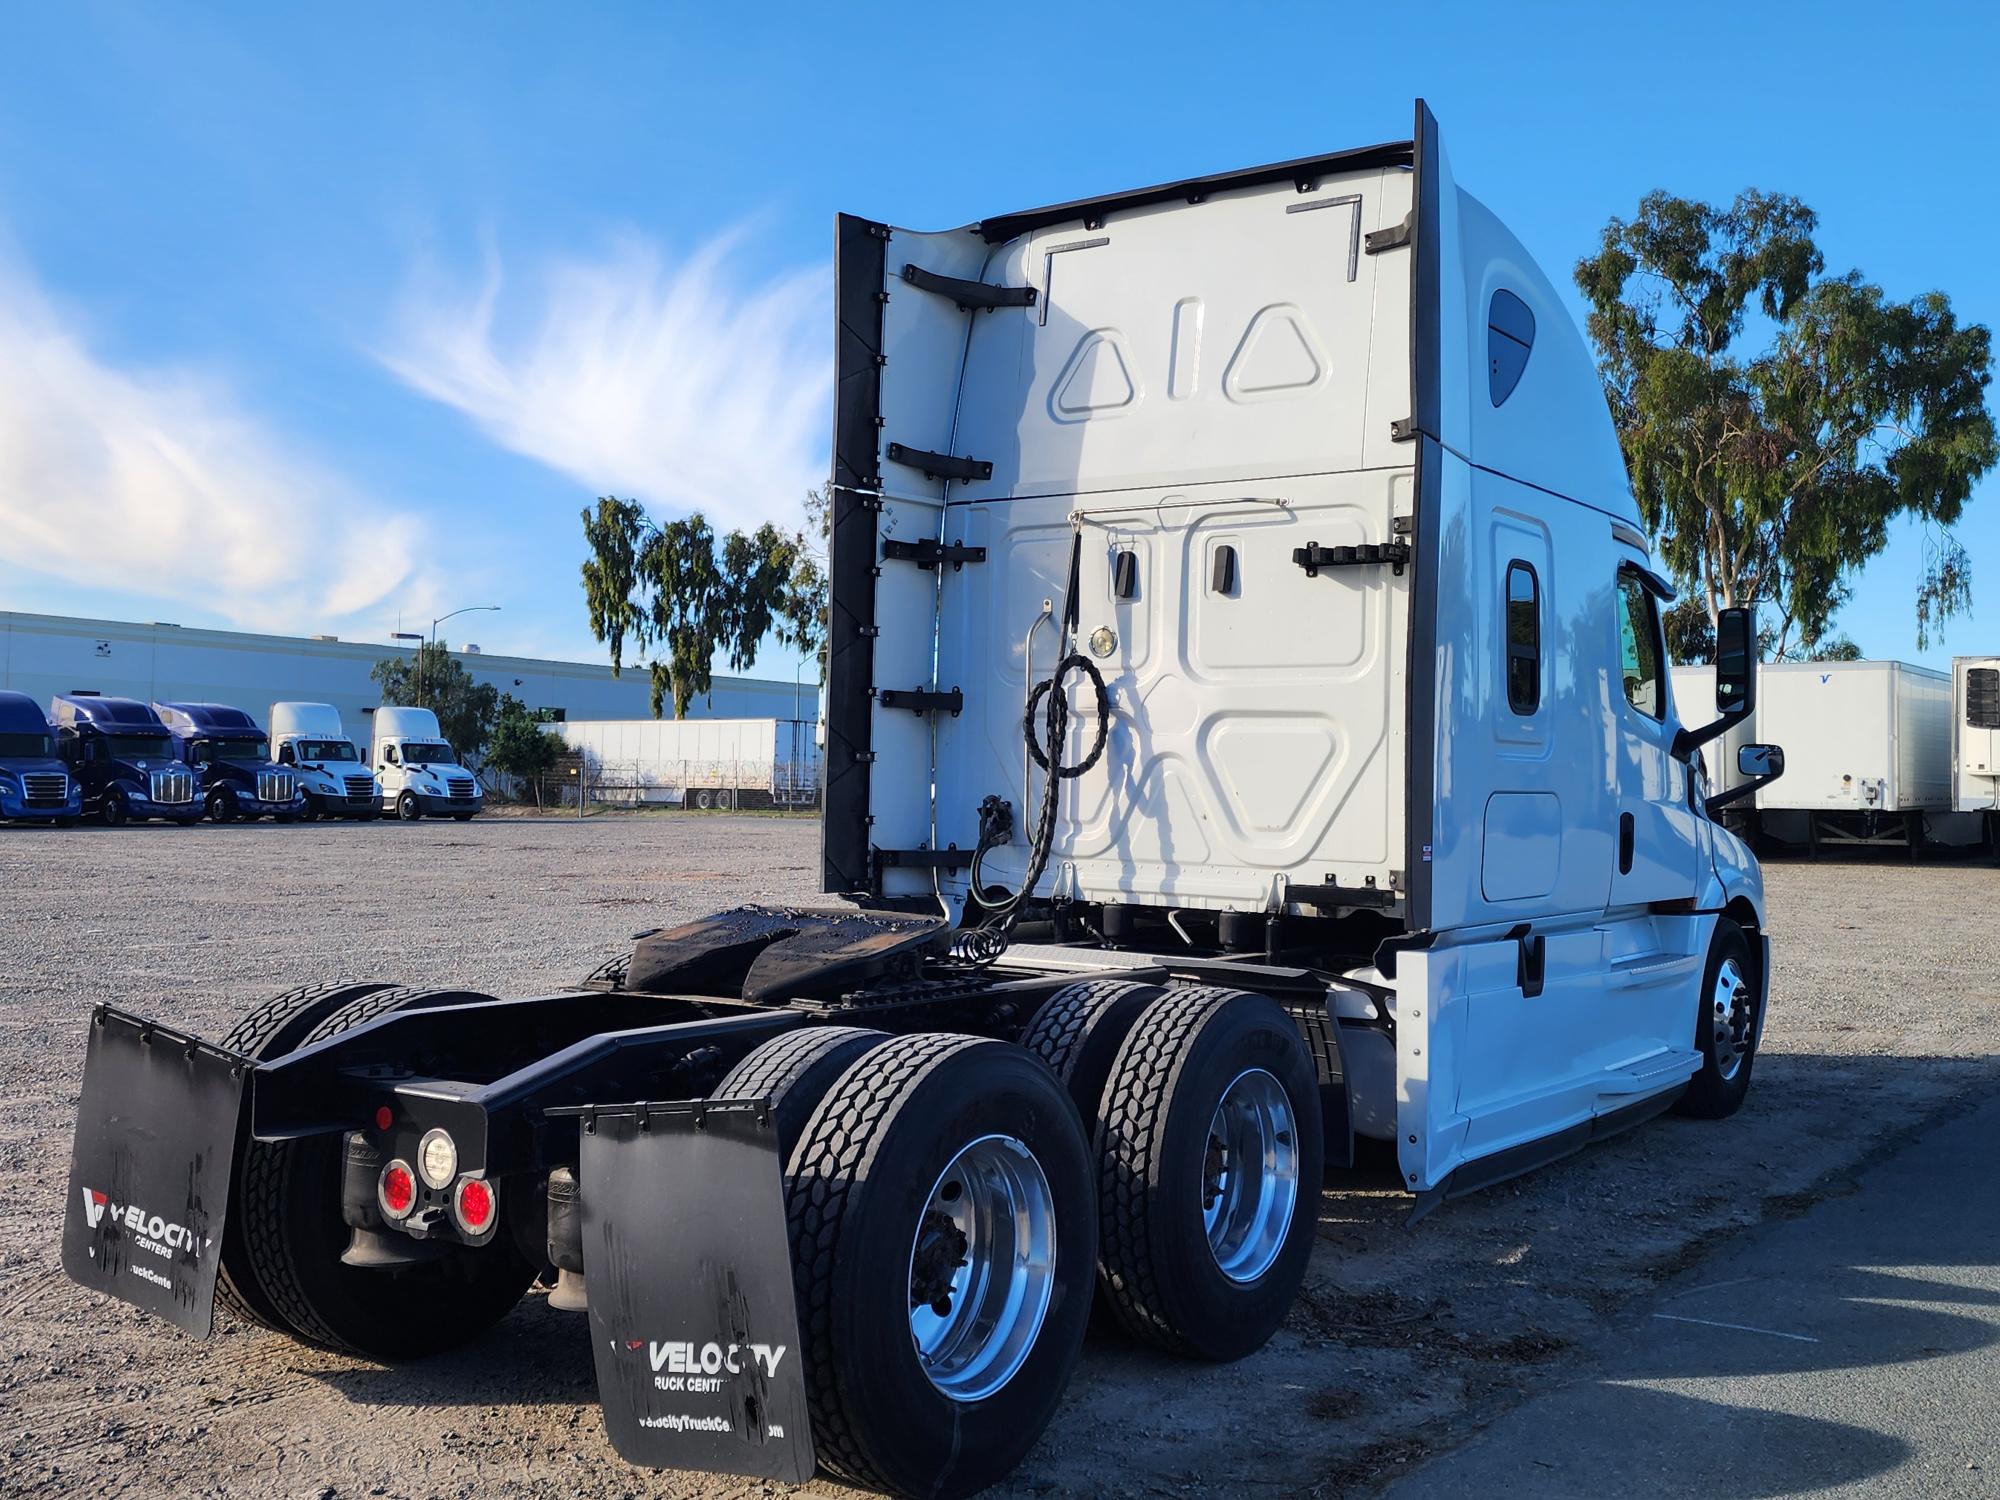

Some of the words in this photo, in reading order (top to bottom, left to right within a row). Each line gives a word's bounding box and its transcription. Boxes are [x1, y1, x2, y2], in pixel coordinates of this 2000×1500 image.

[134, 1234, 173, 1259] CENTERS
[649, 1341, 786, 1378] VELOCTY
[654, 1376, 684, 1391] RUCK
